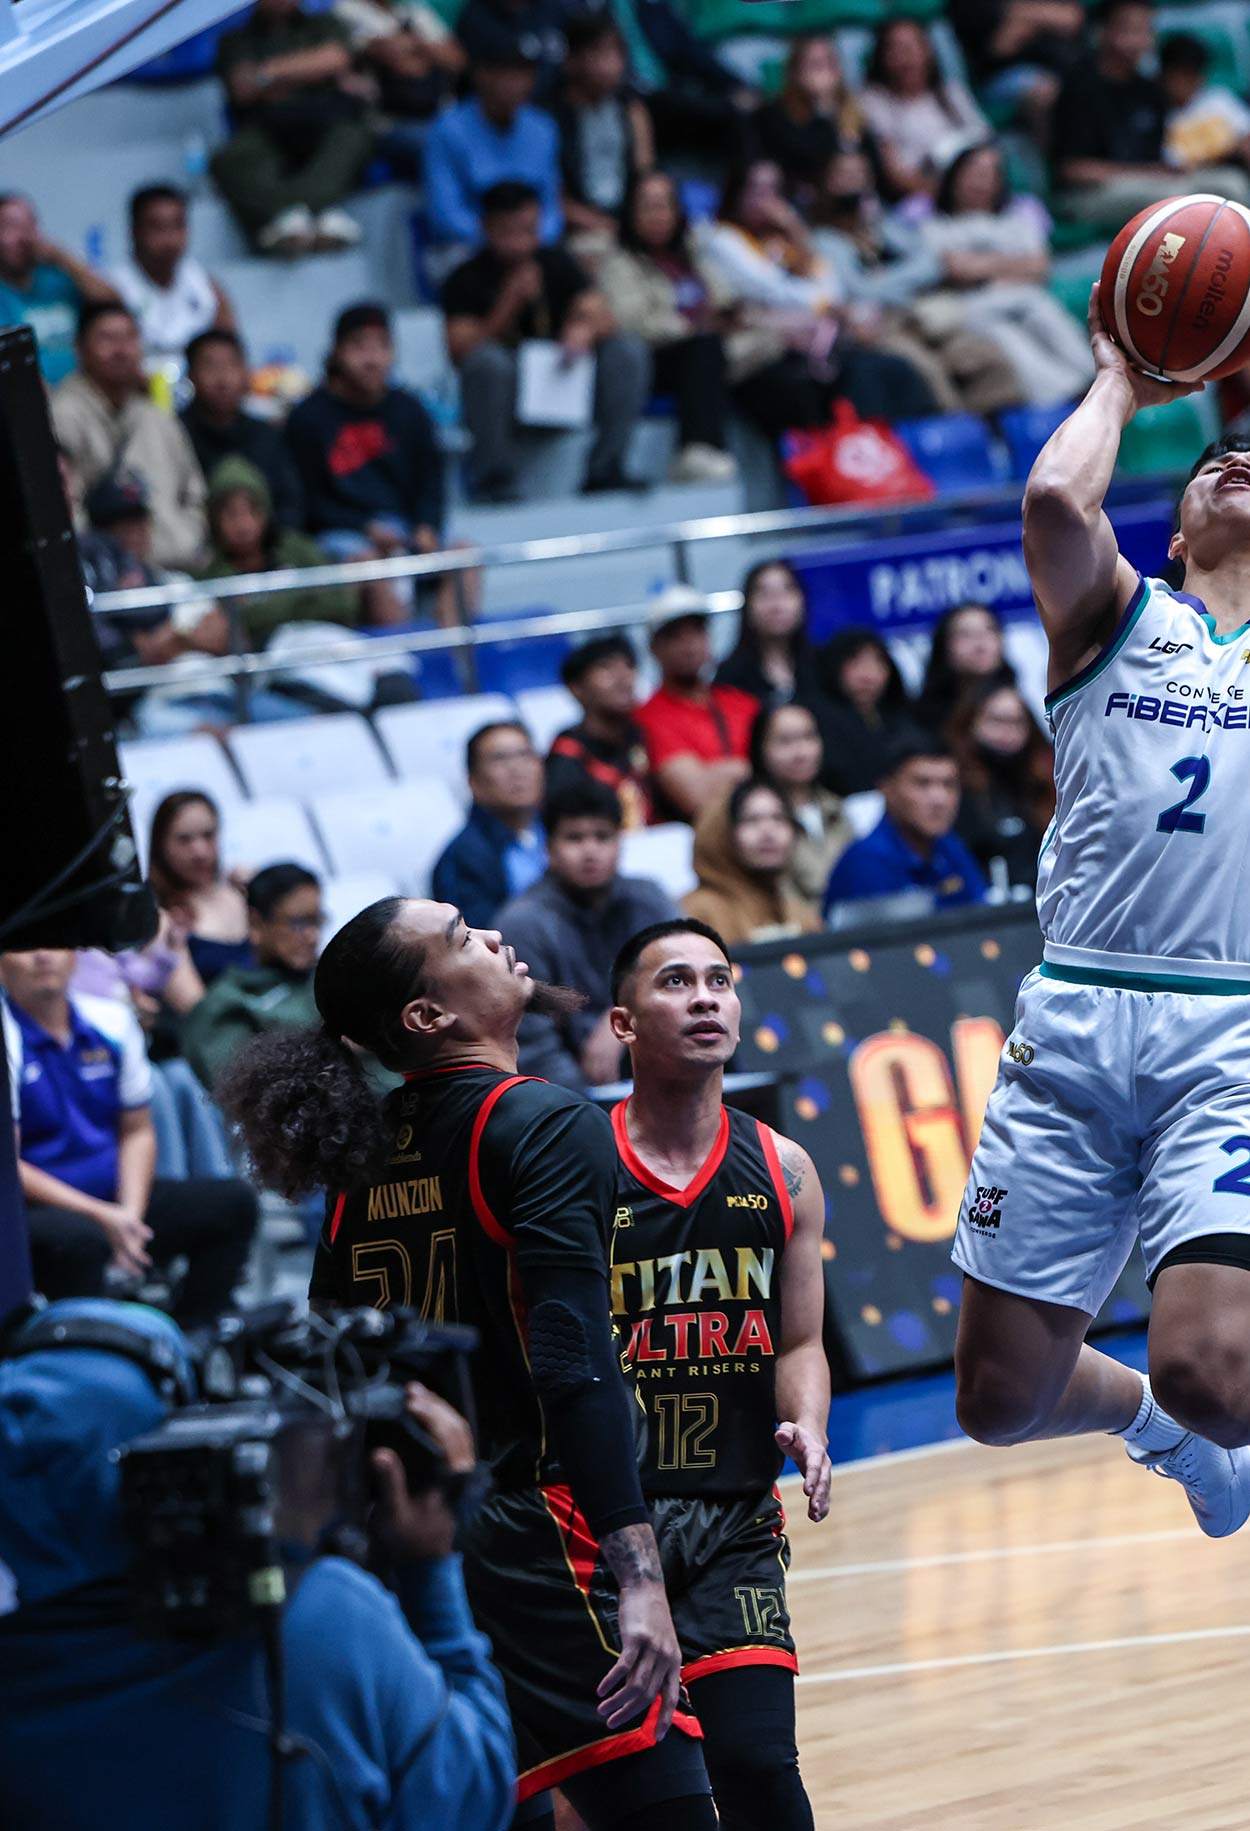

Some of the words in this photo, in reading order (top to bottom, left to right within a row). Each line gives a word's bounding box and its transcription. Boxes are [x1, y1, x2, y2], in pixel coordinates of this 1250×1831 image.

[1192, 249, 1233, 330] molten
[1156, 754, 1211, 834] 2
[367, 1176, 444, 1222] MUNZON
[968, 1206, 1001, 1229] SAWA
[975, 1186, 1008, 1206] SURF
[688, 1362, 760, 1377] RISERS
[654, 1392, 719, 1470] 12
[734, 1586, 786, 1641] 12
